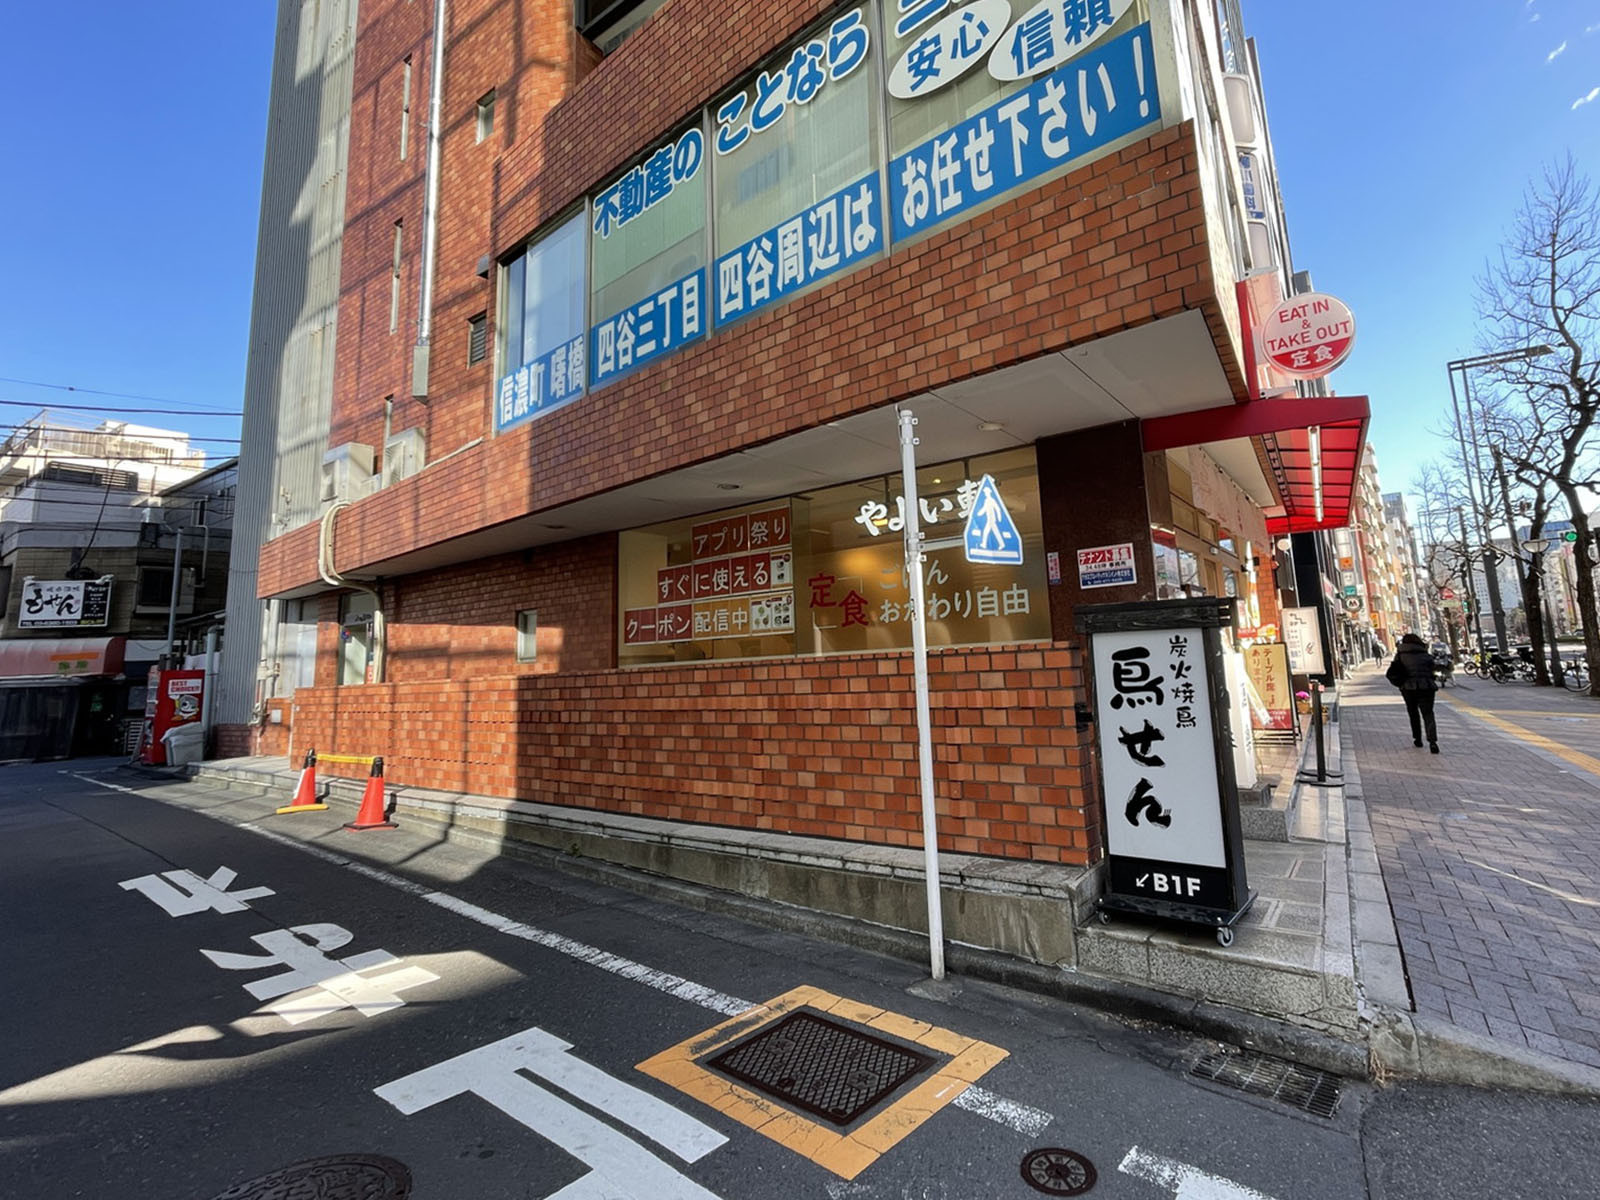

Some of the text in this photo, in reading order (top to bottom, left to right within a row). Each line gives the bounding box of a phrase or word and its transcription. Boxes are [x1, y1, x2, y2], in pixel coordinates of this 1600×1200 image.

[907, 11, 990, 92] 安心
[1010, 0, 1115, 76] 信頼
[594, 8, 869, 239] 不動産の ことなら
[719, 35, 1150, 320] 四谷周辺は お任せ下さい！
[598, 274, 699, 378] 四谷三丁目
[1279, 298, 1330, 323] EAT IN
[1301, 319, 1311, 329] &
[1267, 320, 1351, 352] TAKE OUT
[1290, 344, 1335, 368] 定食
[501, 335, 584, 425] 信濃町 曙橋
[694, 516, 787, 555] アプリ祭り
[658, 561, 769, 599] すぐに使える
[879, 560, 950, 590] ごん
[626, 606, 749, 639] クーポン配信中
[807, 571, 870, 628] 定食
[1168, 634, 1197, 729] 炭火焼鳥
[1109, 646, 1173, 829] 鳥せん
[1152, 872, 1201, 897] B1F
